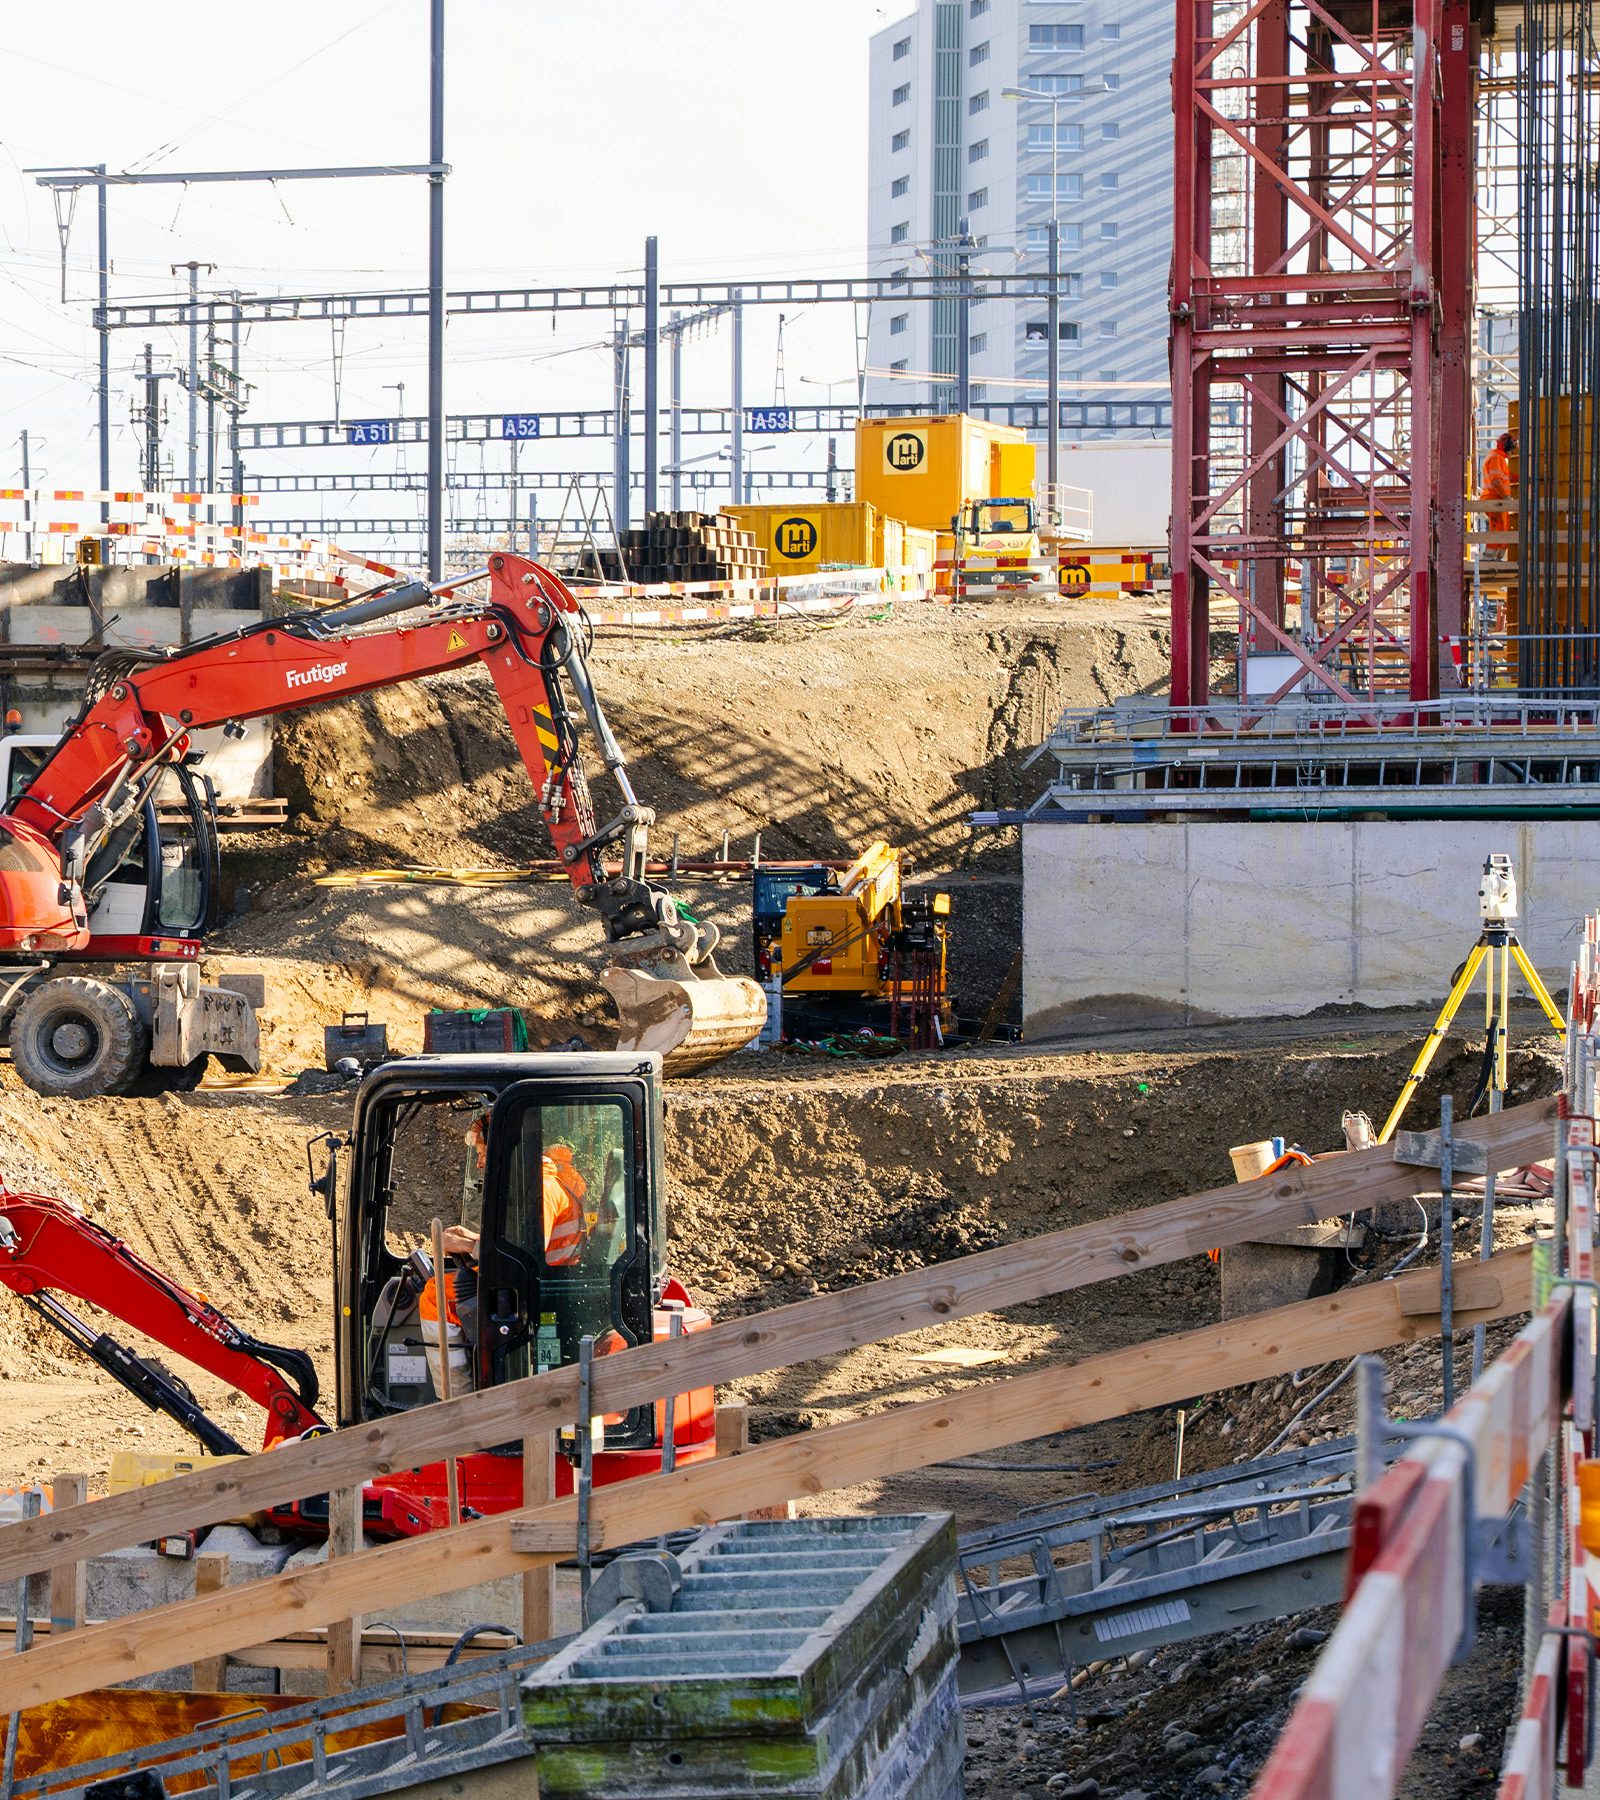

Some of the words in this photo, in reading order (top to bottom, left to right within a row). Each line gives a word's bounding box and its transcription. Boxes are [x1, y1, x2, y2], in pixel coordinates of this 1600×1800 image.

[504, 419, 517, 436] A
[518, 419, 537, 436] 52
[754, 412, 767, 430] A
[767, 412, 787, 430] 53
[354, 424, 366, 441] A
[370, 424, 386, 441] 51
[285, 662, 348, 688] Frutiger
